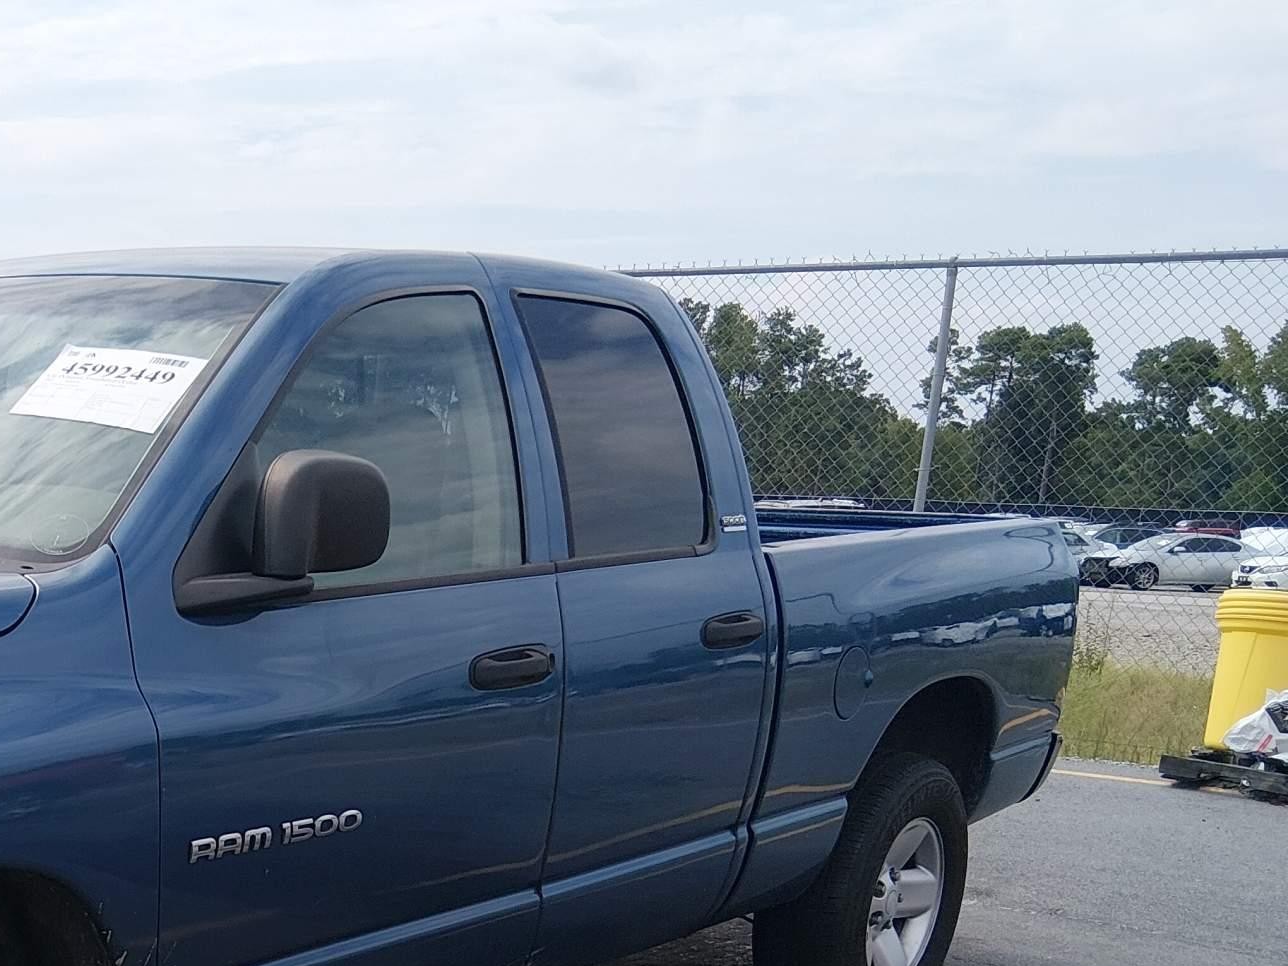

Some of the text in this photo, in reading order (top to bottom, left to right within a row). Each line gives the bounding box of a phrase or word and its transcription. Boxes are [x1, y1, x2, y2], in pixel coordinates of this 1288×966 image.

[62, 362, 175, 384] 45992449
[189, 809, 363, 864] RAM 1500
